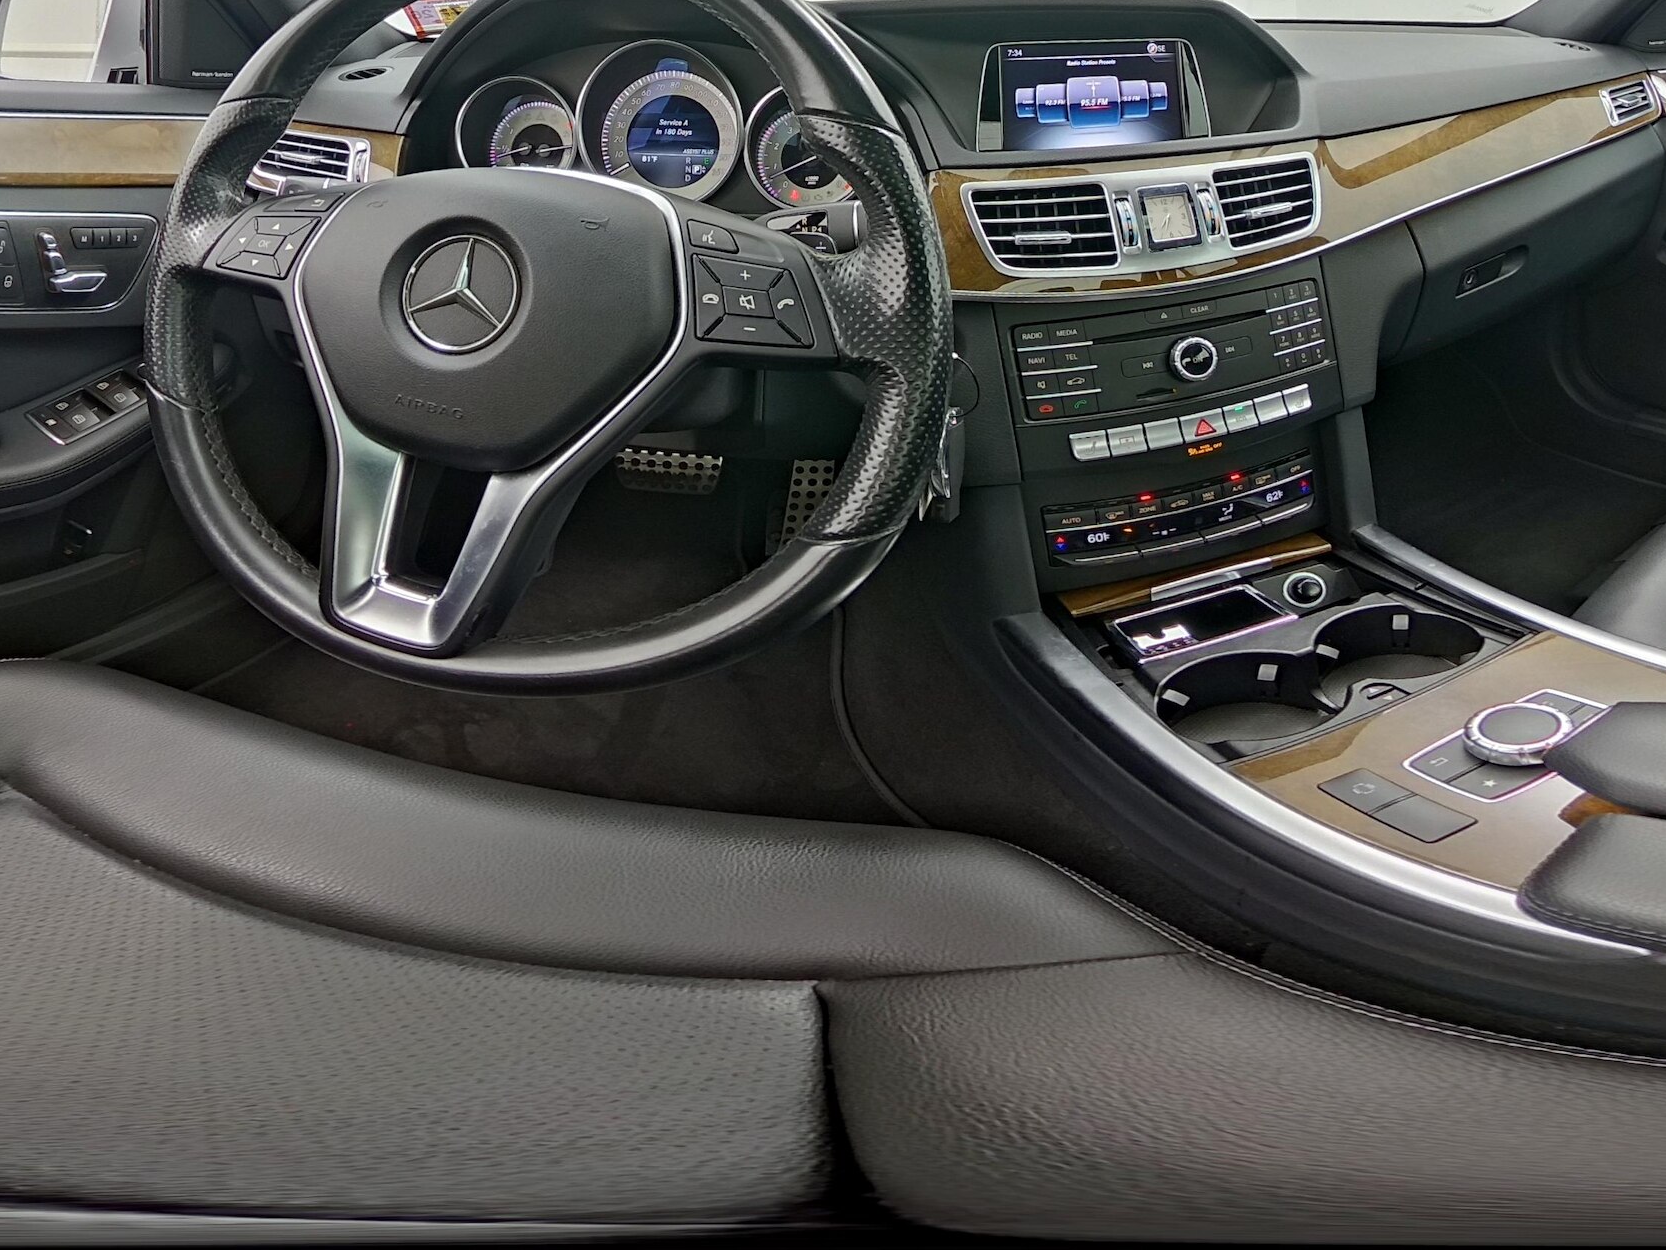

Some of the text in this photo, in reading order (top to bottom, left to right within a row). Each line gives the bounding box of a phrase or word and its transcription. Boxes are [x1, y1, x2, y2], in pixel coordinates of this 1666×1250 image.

[1007, 49, 1023, 57] 7:34
[631, 97, 642, 105] 50
[1096, 97, 1109, 106] FM
[621, 108, 633, 116] 40
[659, 119, 683, 127] Service
[676, 128, 693, 137] Days
[684, 174, 691, 182] D
[258, 239, 270, 249] OK
[1190, 305, 1209, 314] CLEAR
[1022, 332, 1043, 340] RADIO
[1056, 329, 1078, 337] MEDIA
[1028, 357, 1045, 365] NAVI
[394, 393, 465, 420] AIRBAG
[1289, 465, 1302, 473] OFF
[1232, 484, 1244, 492] A/C
[1139, 505, 1157, 514] ZONE
[1062, 517, 1081, 525] AUTO
